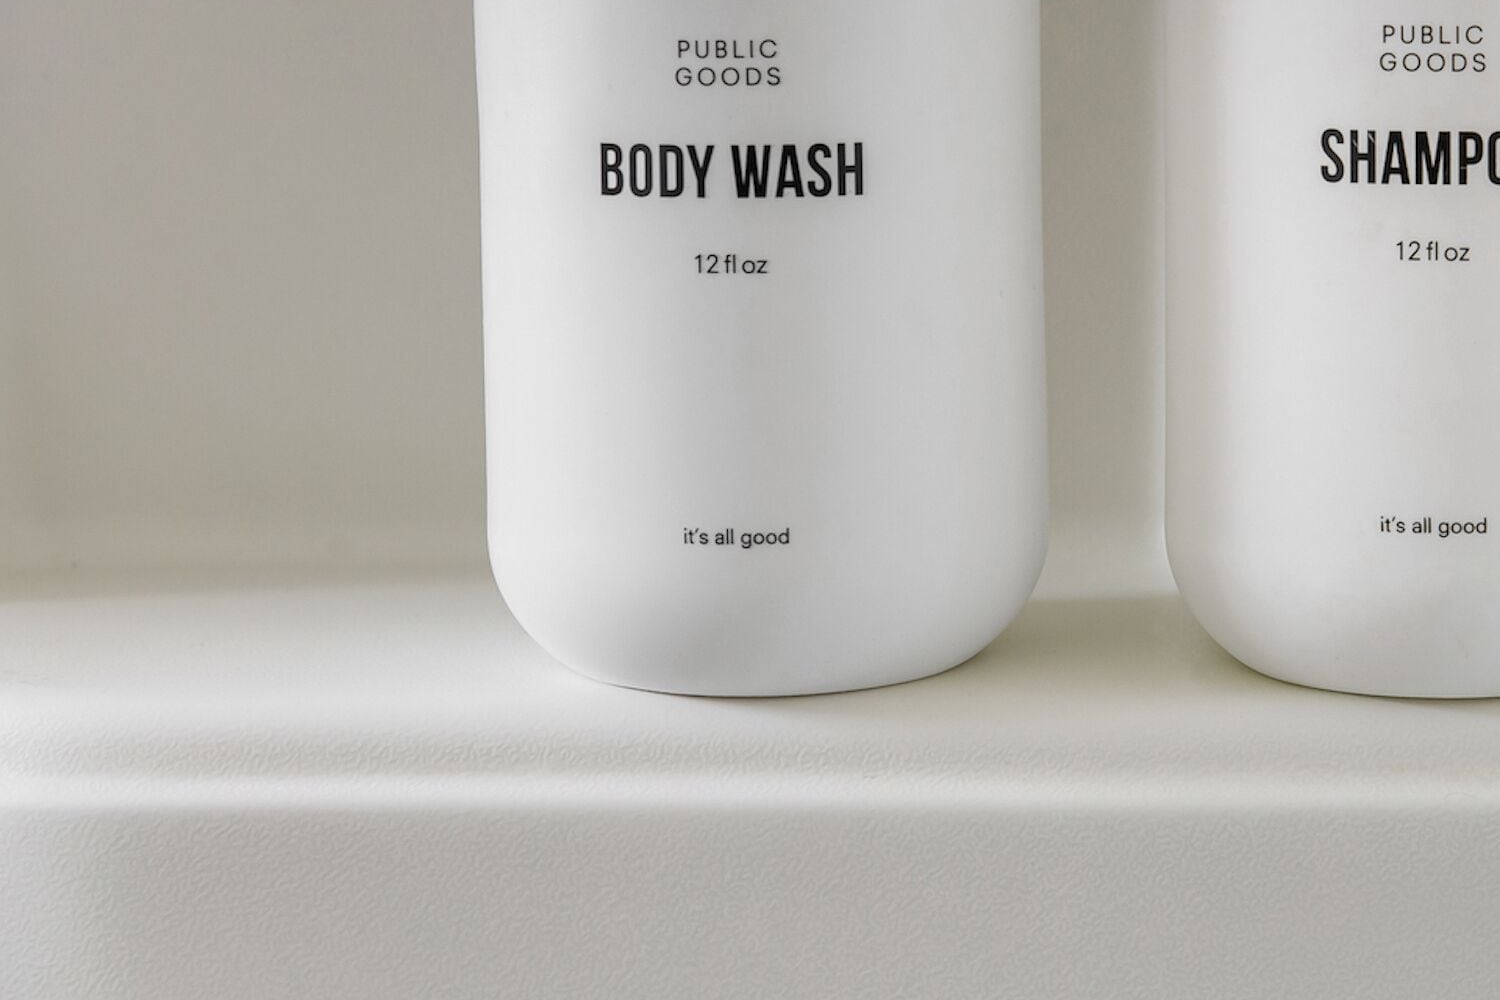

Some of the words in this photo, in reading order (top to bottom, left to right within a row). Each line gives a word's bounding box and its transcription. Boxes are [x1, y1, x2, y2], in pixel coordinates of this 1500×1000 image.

[1382, 24, 1484, 45] PUBLIC
[677, 38, 778, 59] PUBLIC
[1379, 52, 1487, 73] GOODS
[674, 66, 782, 87] GOODS
[599, 142, 716, 200] BODY
[729, 141, 864, 199] WASH
[1395, 240, 1421, 262] 12
[1425, 240, 1439, 262] fl
[1443, 246, 1470, 262] oz
[694, 253, 720, 275] 12
[723, 253, 737, 275] fl
[741, 259, 768, 275] oz
[1380, 515, 1406, 534] it's
[1411, 516, 1433, 534] all
[1437, 516, 1488, 539] good
[683, 527, 710, 546] it's
[714, 527, 735, 546] all
[740, 527, 790, 550] good
